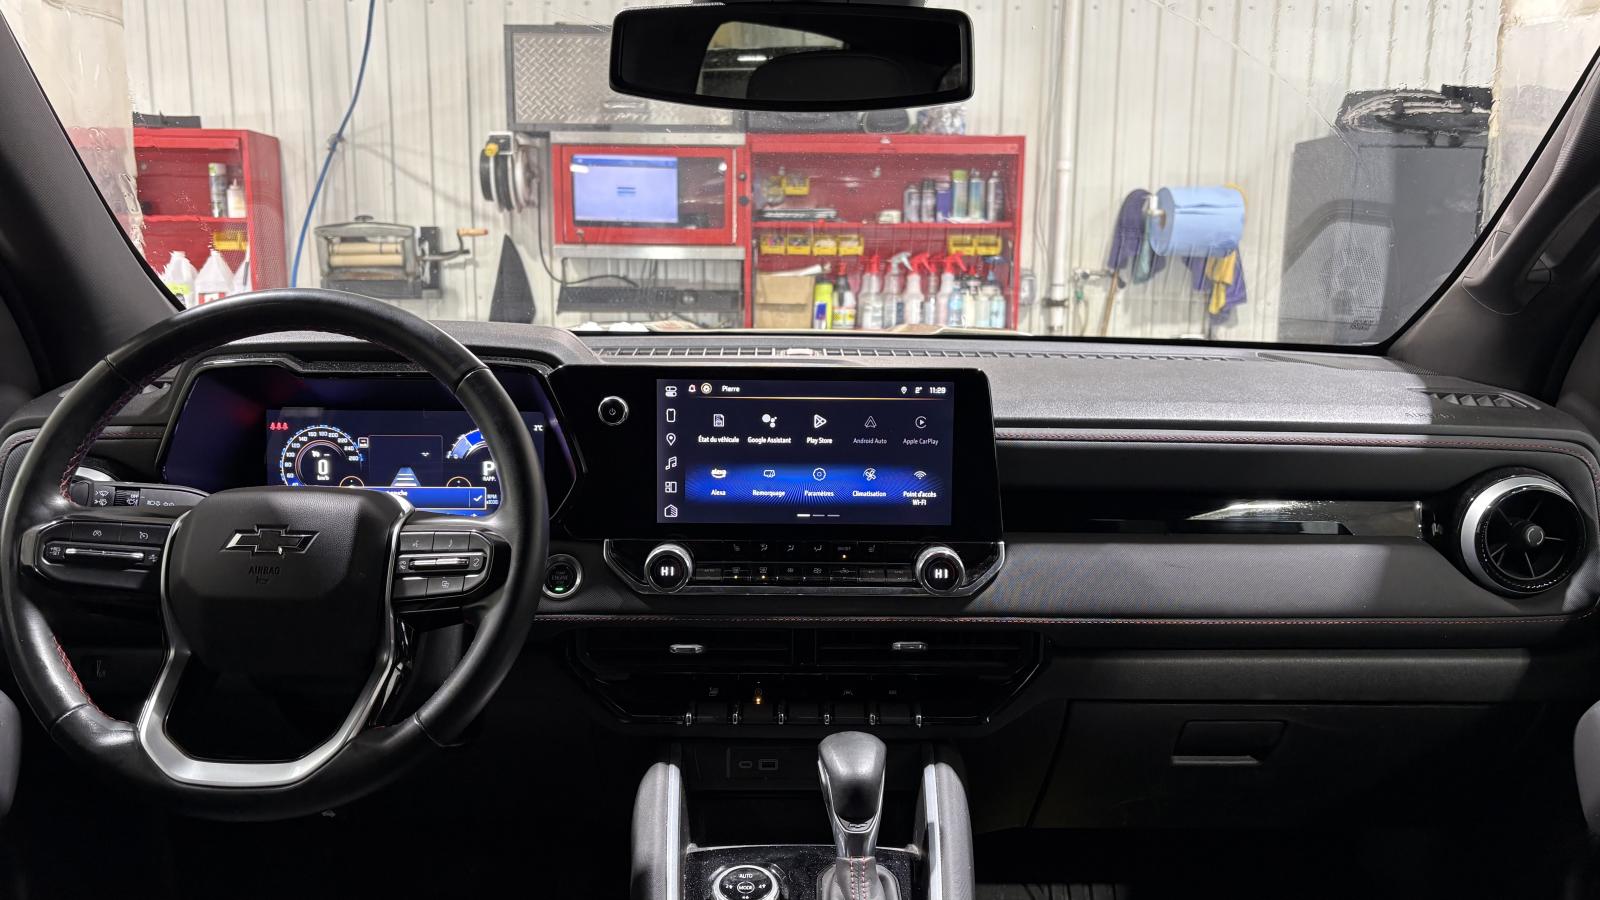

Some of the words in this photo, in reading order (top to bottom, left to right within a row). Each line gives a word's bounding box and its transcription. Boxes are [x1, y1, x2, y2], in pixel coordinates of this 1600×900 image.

[929, 386, 947, 394] 11:29
[698, 434, 709, 443] État
[709, 435, 717, 443] du
[717, 435, 739, 443] véhicule
[747, 436, 766, 445] Google
[766, 436, 791, 444] Assistant
[806, 436, 818, 445] Play
[818, 436, 832, 444] Store
[902, 438, 918, 446] Apple
[918, 437, 939, 446] CarPlay
[317, 459, 329, 475] 0
[482, 460, 497, 476] P
[711, 488, 726, 496] Alexa
[752, 489, 786, 498] Remorquage
[903, 490, 917, 498] Point
[917, 490, 937, 498] d'accès
[660, 566, 675, 577] HI
[934, 568, 949, 579] HI
